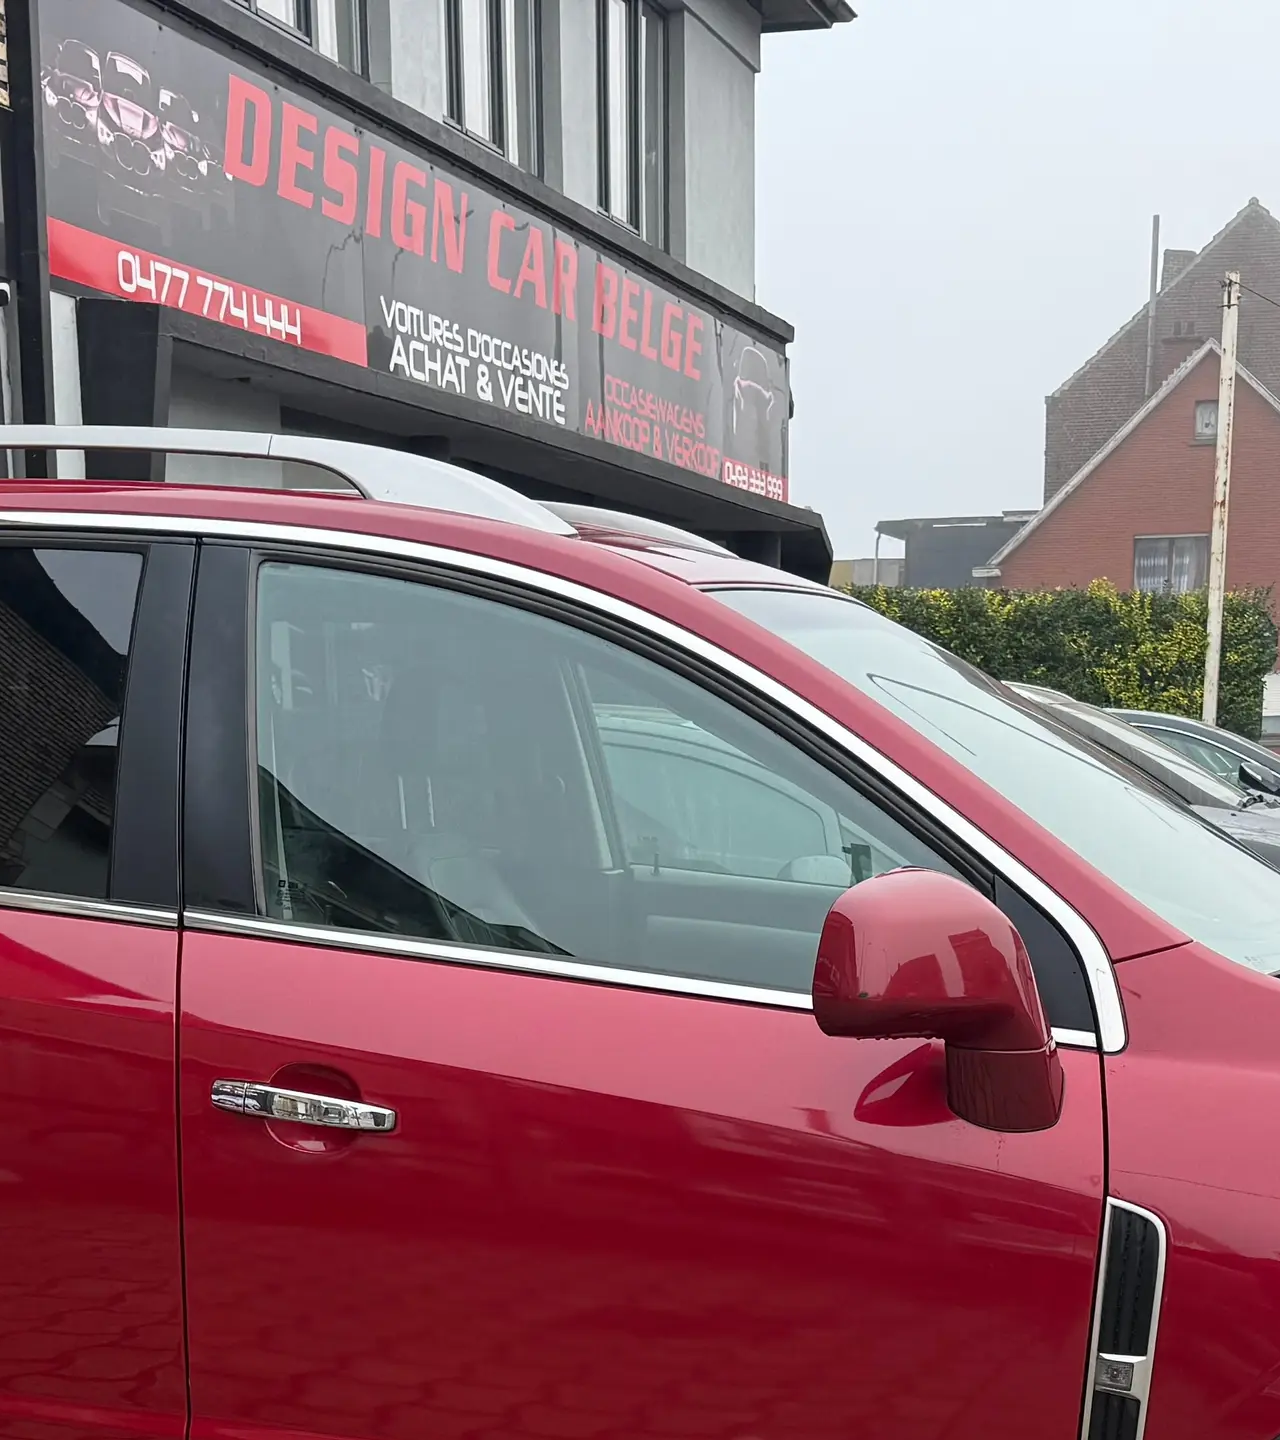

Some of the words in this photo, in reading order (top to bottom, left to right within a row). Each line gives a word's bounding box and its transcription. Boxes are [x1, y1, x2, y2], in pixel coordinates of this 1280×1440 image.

[223, 74, 468, 273] DESIGN
[487, 209, 579, 321] CAR
[591, 261, 704, 381] BELGE
[118, 250, 189, 309] 0477
[197, 276, 248, 329] 774
[252, 294, 302, 345] 444
[380, 295, 464, 353] VOITURES
[468, 328, 569, 390] D'OCCASIONES
[389, 334, 470, 394] ACHAT
[477, 364, 494, 402] &
[498, 370, 566, 425] VENTE
[585, 398, 650, 453] AANKOOP
[653, 425, 663, 460] &
[724, 461, 748, 491] 0493
